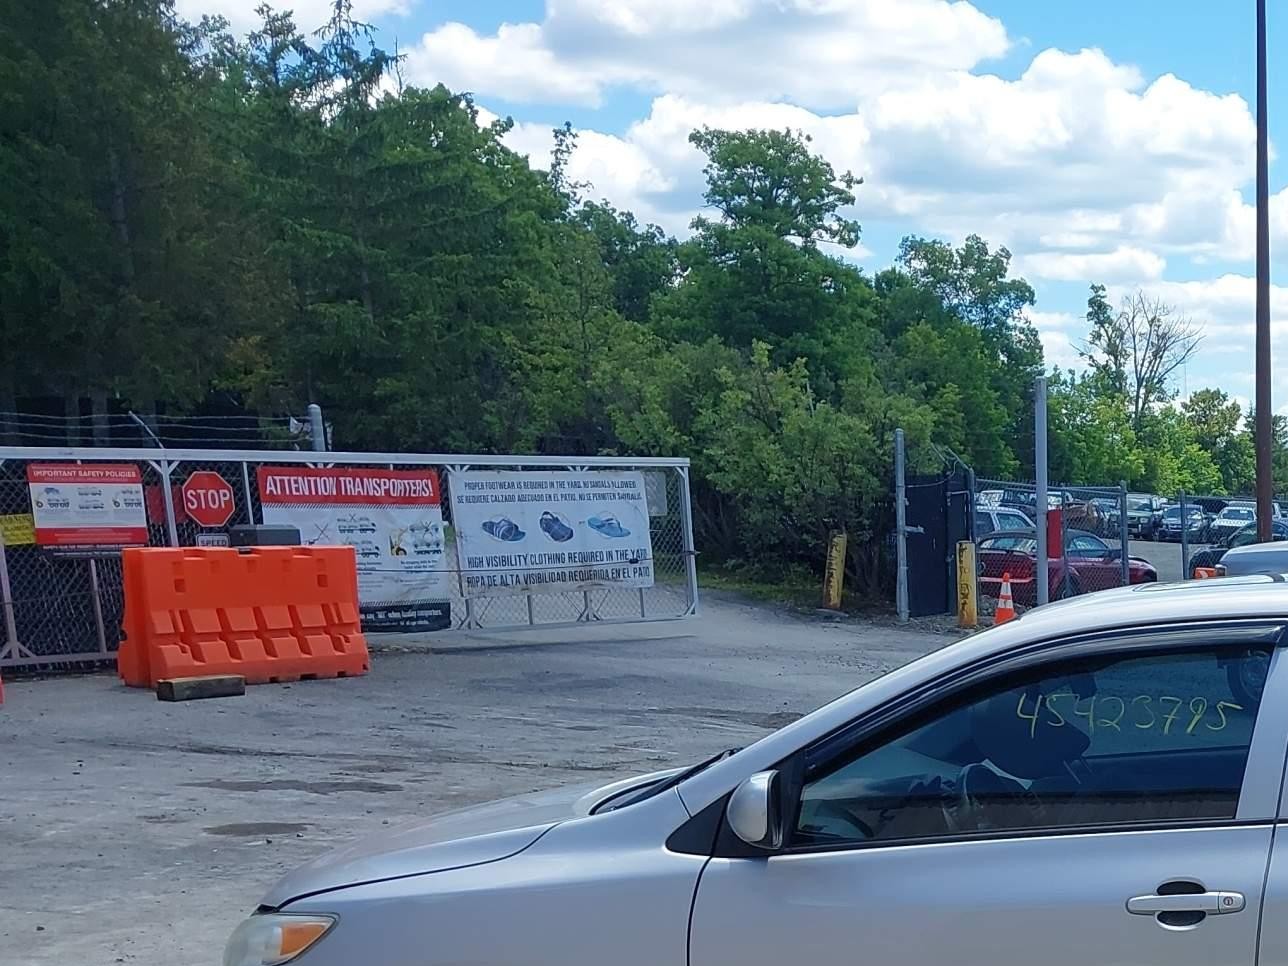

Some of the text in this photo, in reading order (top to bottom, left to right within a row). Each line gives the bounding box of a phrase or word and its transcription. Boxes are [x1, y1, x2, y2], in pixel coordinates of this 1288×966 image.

[33, 470, 137, 478] IMPORTANT SAFETY POLICIES
[266, 475, 434, 497] ATTENTION TRANSPORTERS!
[464, 481, 485, 490] PROPER
[485, 481, 516, 490] FOOTWEAR
[516, 481, 523, 489] IS
[523, 480, 549, 490] REQUIRED
[549, 480, 555, 489] IN
[556, 480, 566, 489] THE
[186, 488, 230, 510] STOP
[457, 495, 465, 504] SE
[465, 494, 490, 504] REQUIERE
[490, 494, 516, 503] CALZADO
[545, 493, 552, 502] EN
[553, 493, 560, 502] EL
[467, 556, 484, 568] HIGH
[485, 554, 528, 567] VISIBILITY
[529, 552, 566, 565] CLOTHING
[567, 550, 604, 563] REQUIRED
[605, 550, 614, 562] IN
[615, 549, 629, 561] THE
[466, 575, 486, 588] ROPA
[487, 574, 498, 587] DE
[499, 573, 521, 586] ALTA
[522, 571, 567, 585] VISIBILIDAD
[568, 568, 610, 582] REQUERIDA
[610, 567, 621, 579] EN
[622, 567, 631, 578] EL
[1016, 693, 1243, 738] 45423795
